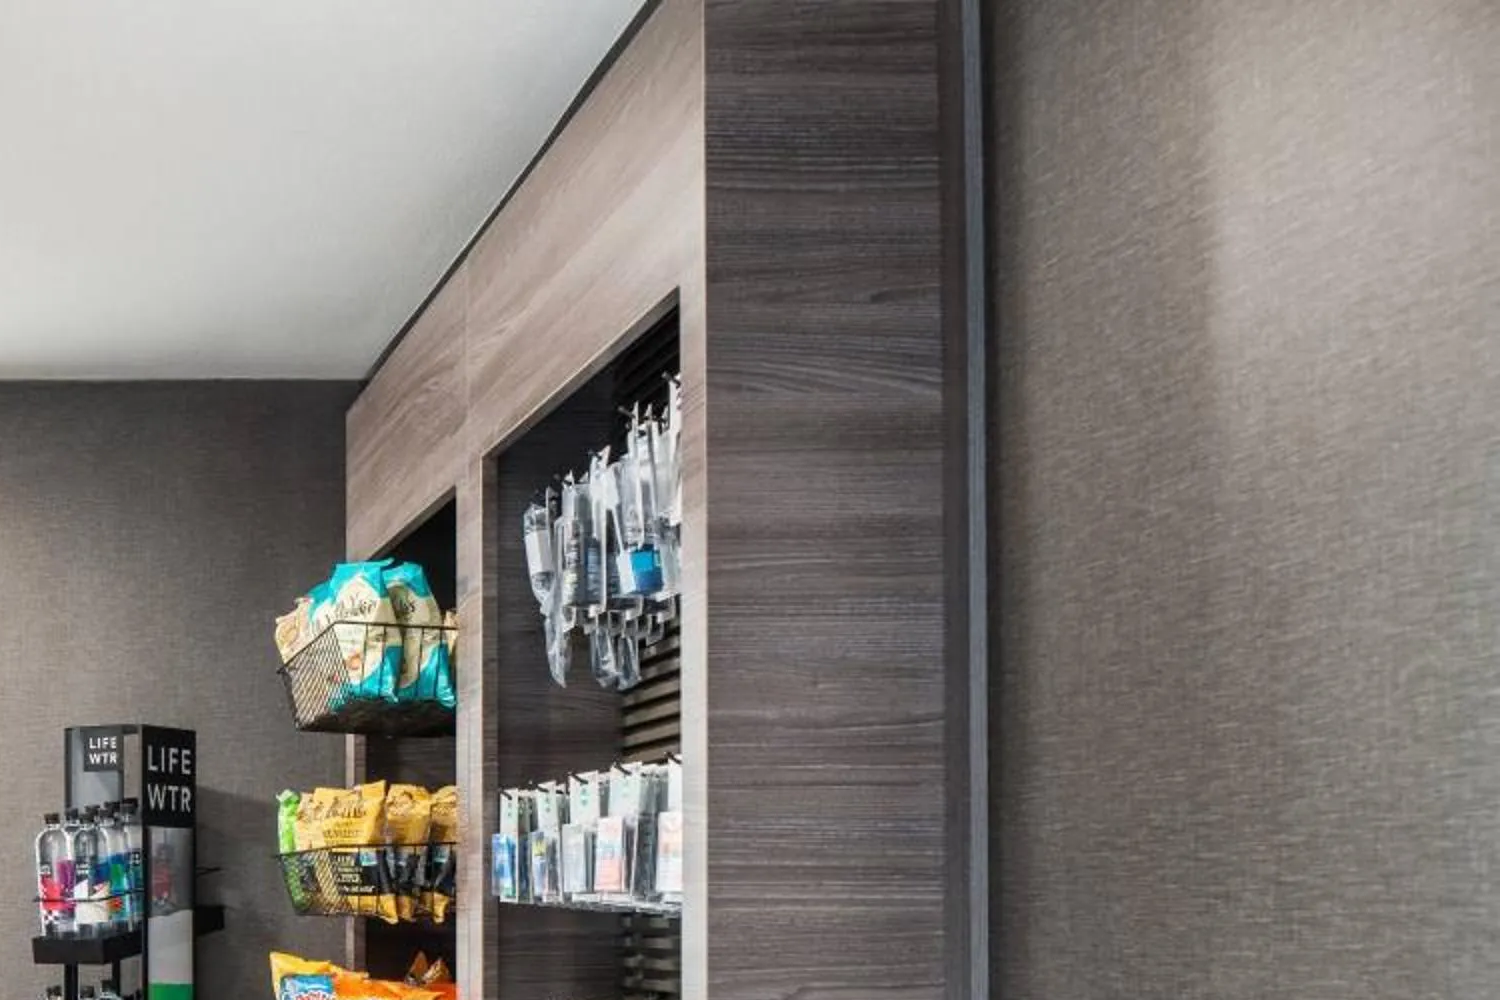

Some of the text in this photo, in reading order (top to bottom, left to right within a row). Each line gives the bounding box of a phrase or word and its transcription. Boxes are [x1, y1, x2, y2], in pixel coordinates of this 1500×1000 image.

[88, 735, 117, 749] LIFE
[88, 752, 117, 765] WTR
[147, 745, 191, 775] LIFE
[147, 784, 191, 813] WTR
